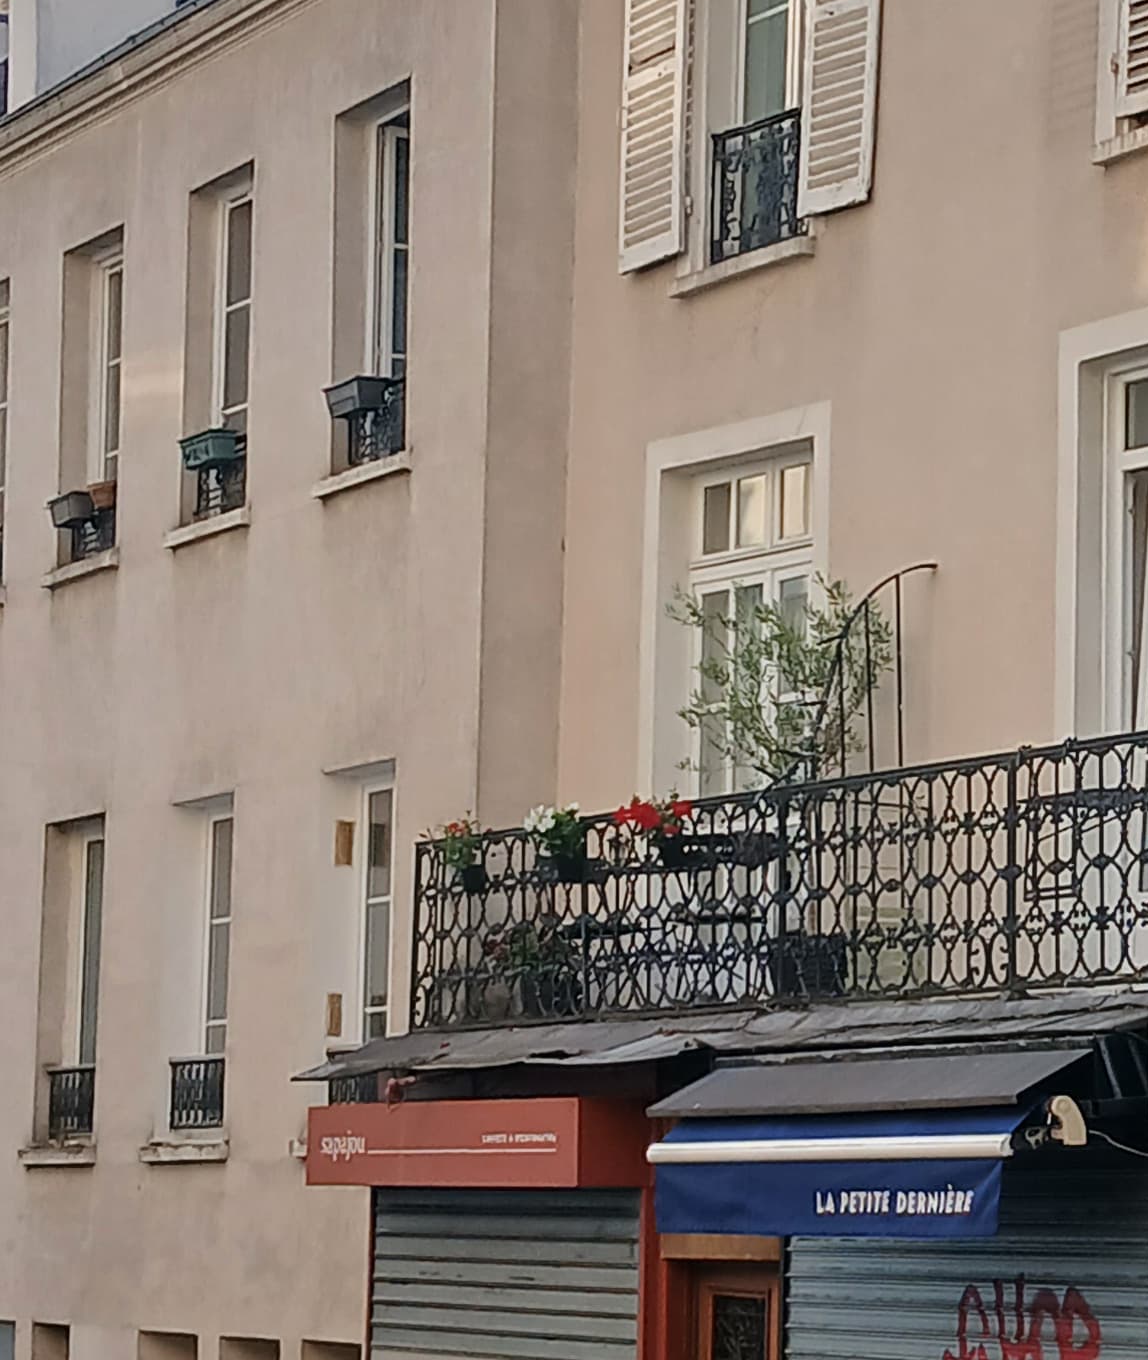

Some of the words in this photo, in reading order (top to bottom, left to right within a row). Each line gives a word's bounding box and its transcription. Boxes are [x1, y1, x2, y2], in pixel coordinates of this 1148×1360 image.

[816, 1191, 835, 1214] LA
[839, 1191, 890, 1214] PETITE
[896, 1183, 974, 1214] DERNIÈRE
